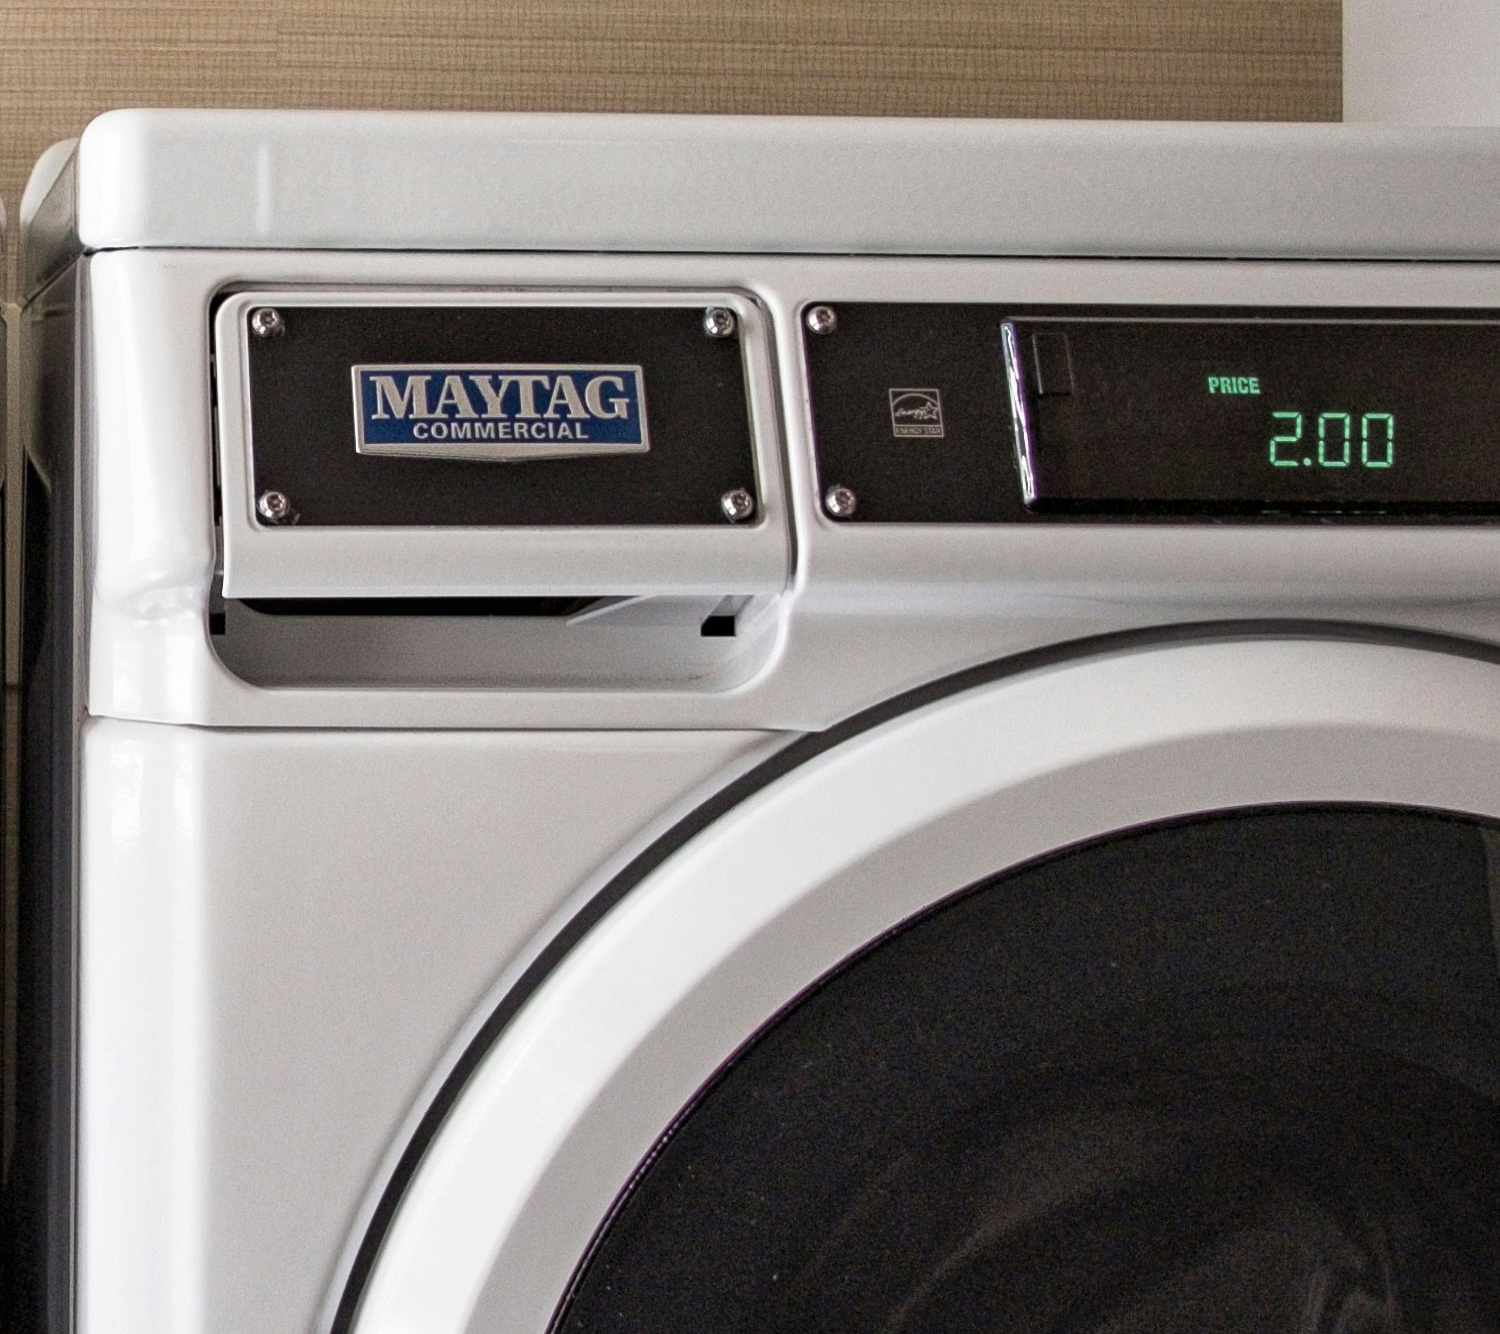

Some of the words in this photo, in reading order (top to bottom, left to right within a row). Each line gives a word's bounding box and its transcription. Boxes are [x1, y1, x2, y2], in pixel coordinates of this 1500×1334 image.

[368, 375, 629, 420] MAYTAG
[1208, 376, 1261, 395] PRICE
[413, 422, 589, 440] COMMERCIAL
[1269, 411, 1394, 468] 2.00
